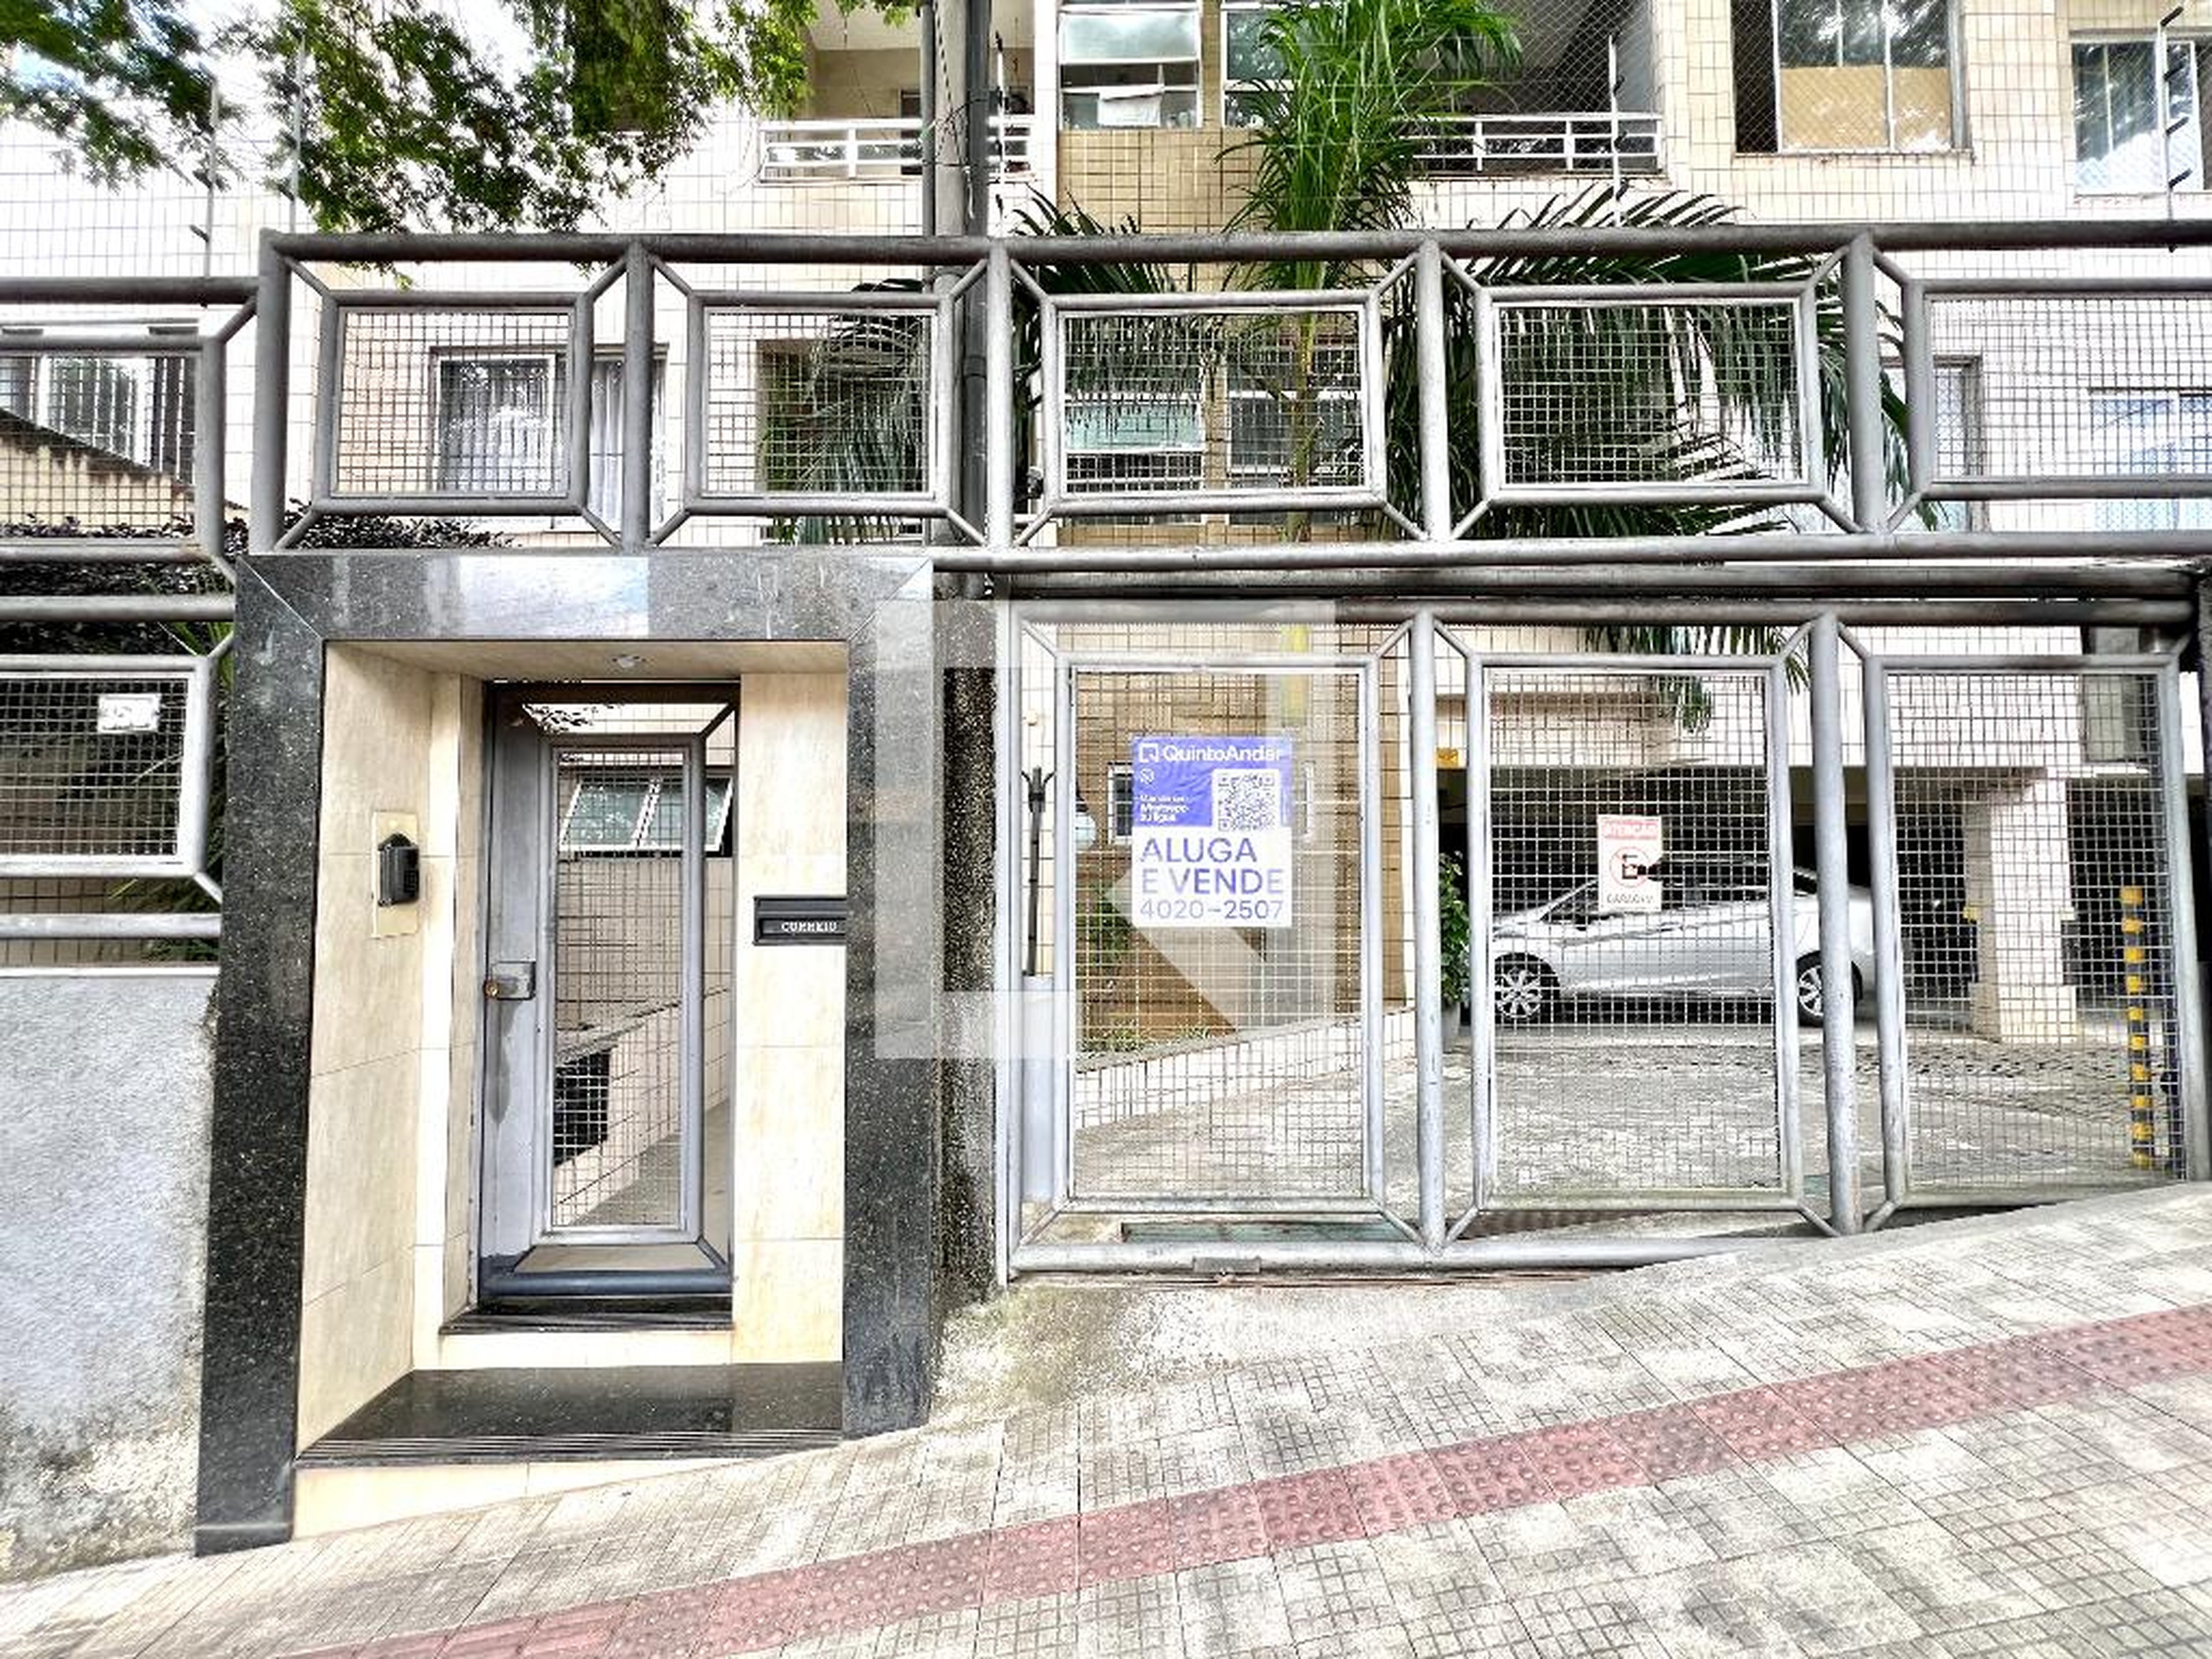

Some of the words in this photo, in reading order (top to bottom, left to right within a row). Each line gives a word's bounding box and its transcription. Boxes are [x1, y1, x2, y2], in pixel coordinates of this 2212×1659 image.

[1162, 744, 1282, 762] QuintoAndar
[1140, 838, 1257, 863] ALUGA
[1142, 868, 1159, 895] E
[1169, 868, 1284, 895] VENDE
[1140, 900, 1284, 919] 4020-2507
